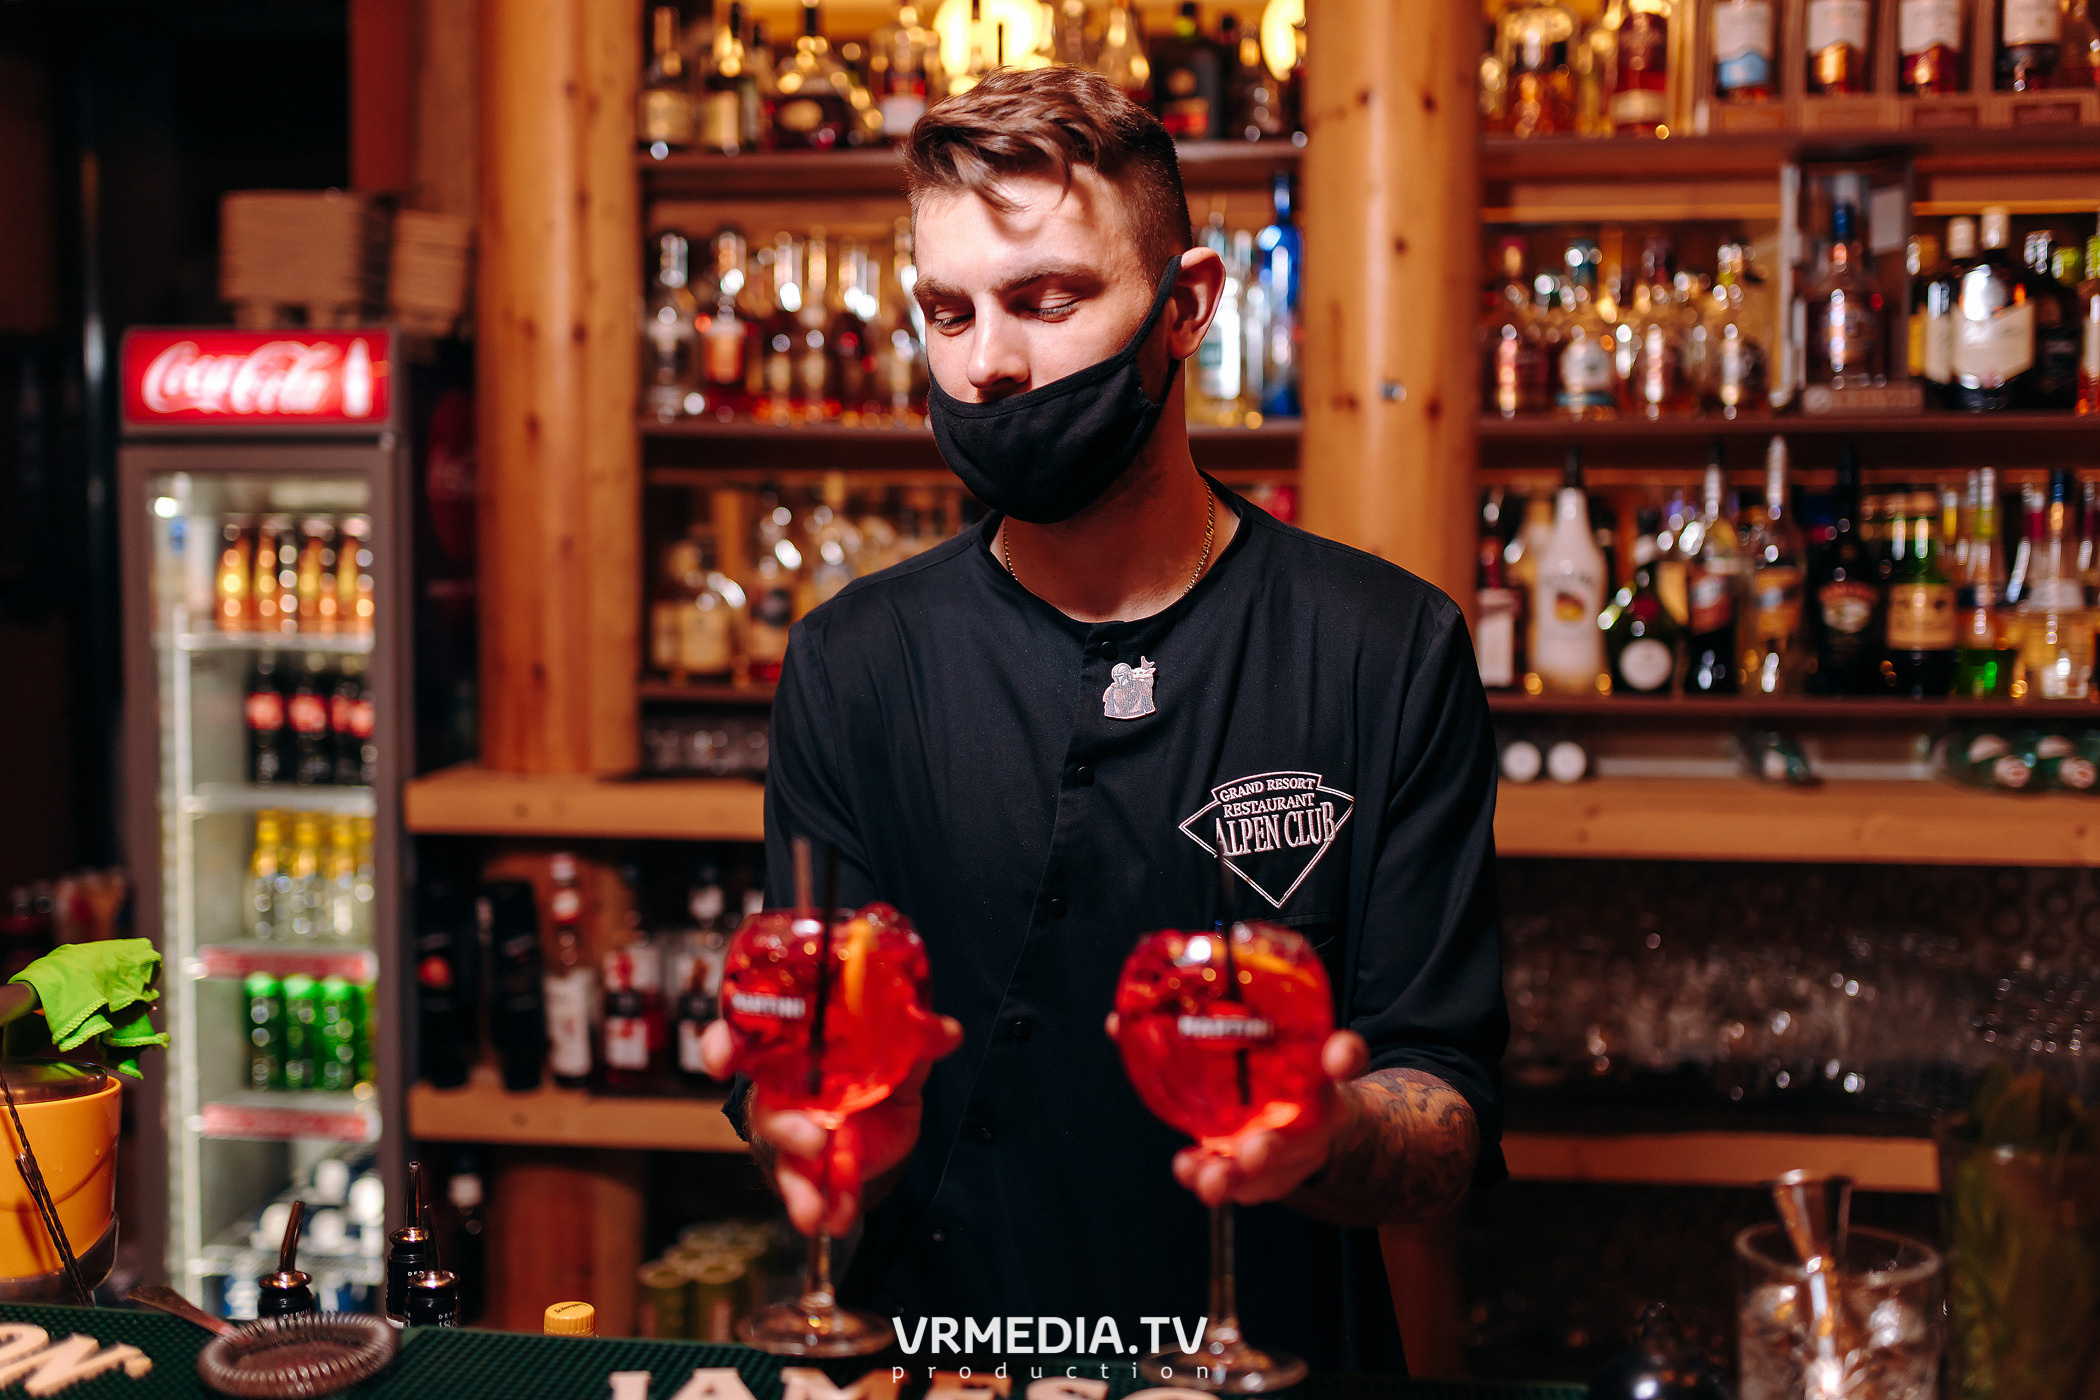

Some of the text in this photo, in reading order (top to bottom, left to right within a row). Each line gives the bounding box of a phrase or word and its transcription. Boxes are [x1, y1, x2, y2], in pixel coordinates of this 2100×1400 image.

[1219, 777, 1317, 802] GRAND RESORT
[1222, 792, 1315, 818] RESTAURANT
[1215, 801, 1337, 857] ALPEN CLUB
